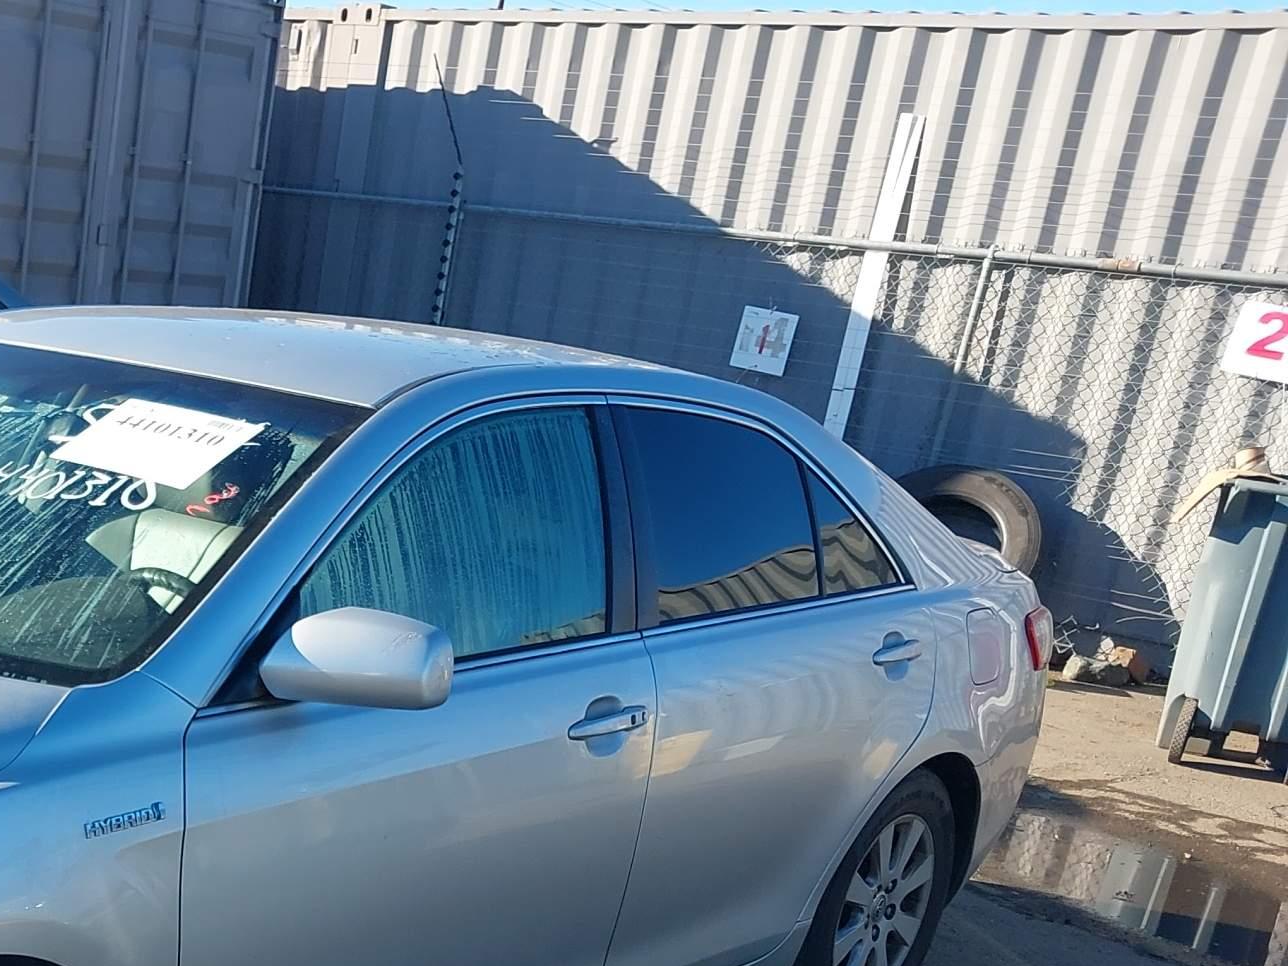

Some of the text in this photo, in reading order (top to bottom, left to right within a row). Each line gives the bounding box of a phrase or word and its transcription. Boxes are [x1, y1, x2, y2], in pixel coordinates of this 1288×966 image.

[1246, 311, 1288, 361] 2
[116, 415, 225, 446] 44101310
[83, 808, 153, 839] HYBRID
